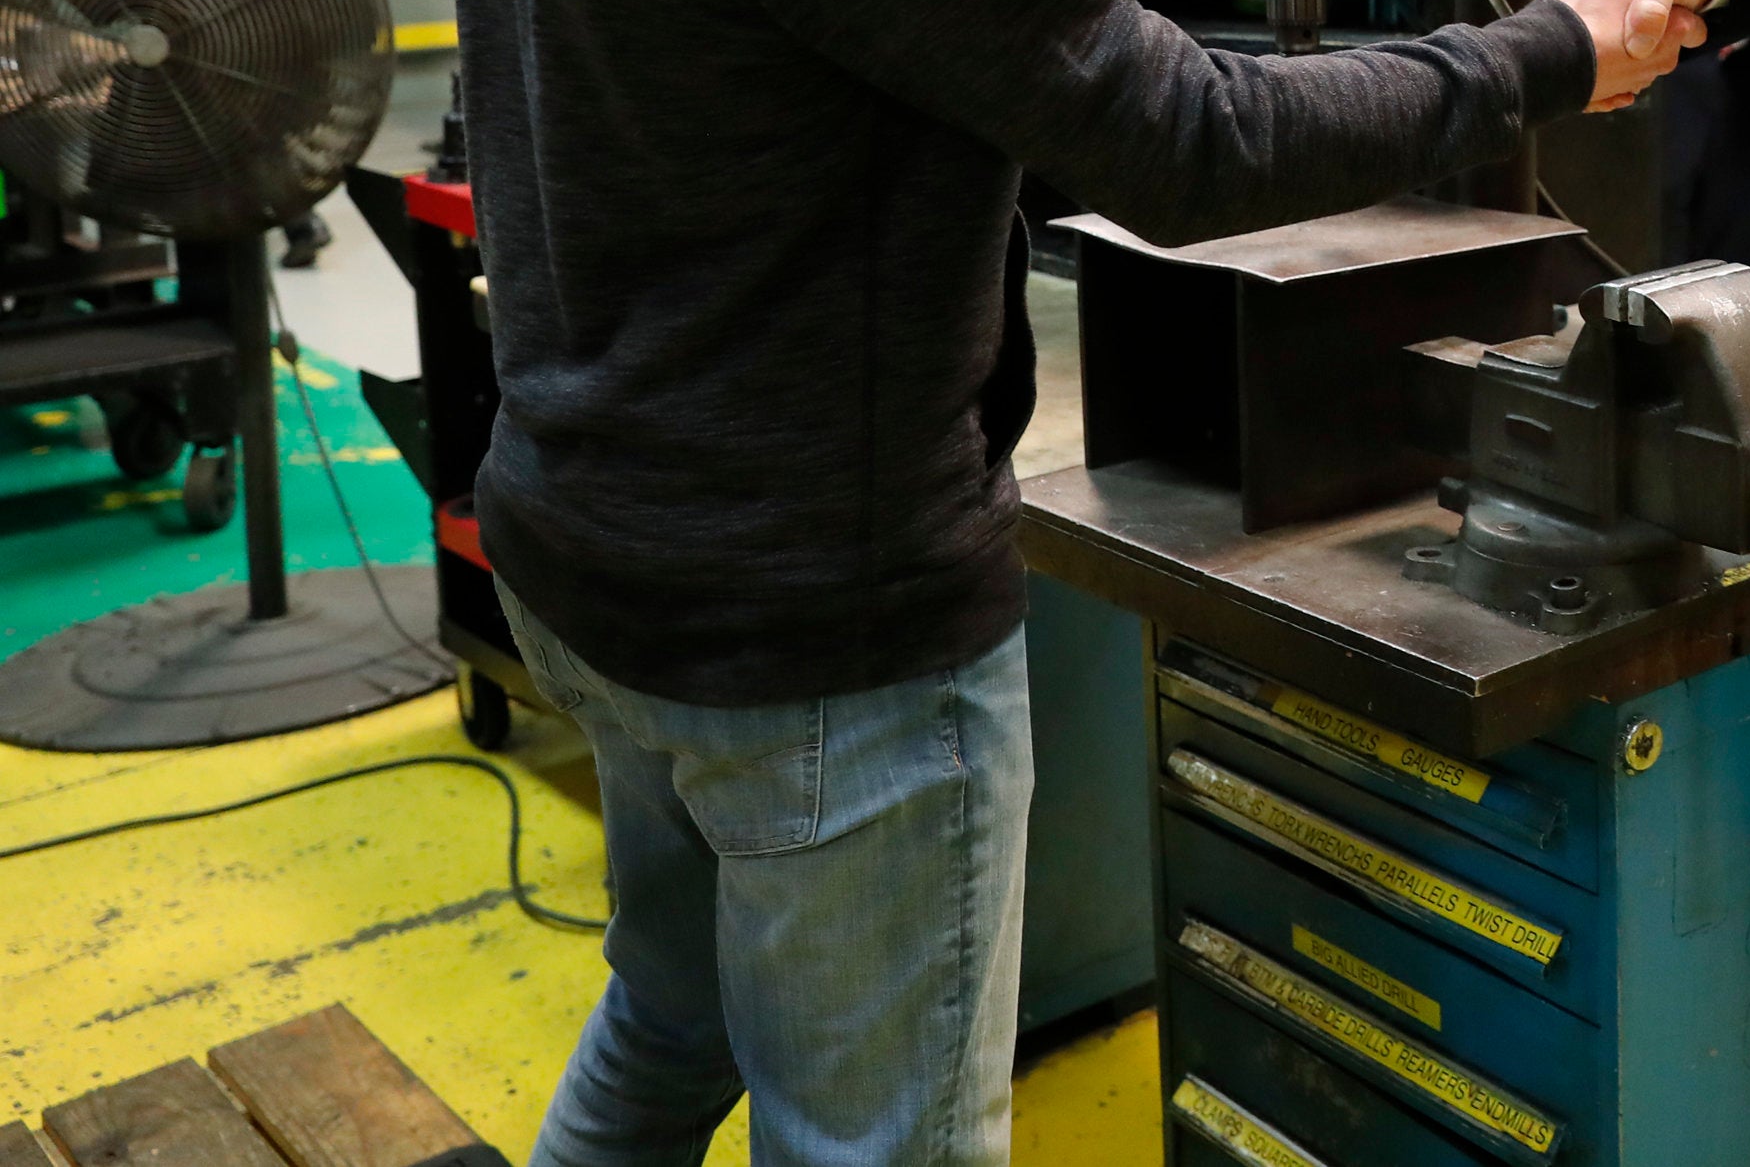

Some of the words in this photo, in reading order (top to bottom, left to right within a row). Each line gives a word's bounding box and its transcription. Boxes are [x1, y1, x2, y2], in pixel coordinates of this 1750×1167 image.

[1294, 702, 1332, 730] HAND
[1333, 717, 1380, 752] TOOLS
[1401, 746, 1465, 787] GAUGES
[1268, 806, 1301, 837] TORX
[1303, 824, 1373, 871] WRENCHS
[1376, 860, 1459, 912] PARALLELS
[1463, 901, 1512, 936] TWIST
[1512, 925, 1556, 960] DRILL
[1312, 939, 1334, 964] BIG
[1335, 954, 1379, 990] ALLIED
[1382, 976, 1420, 1014] DRILL
[1343, 1018, 1394, 1058] DRILLS
[1396, 1047, 1470, 1101] REAMERS
[1471, 1089, 1548, 1145] ENDMILLS
